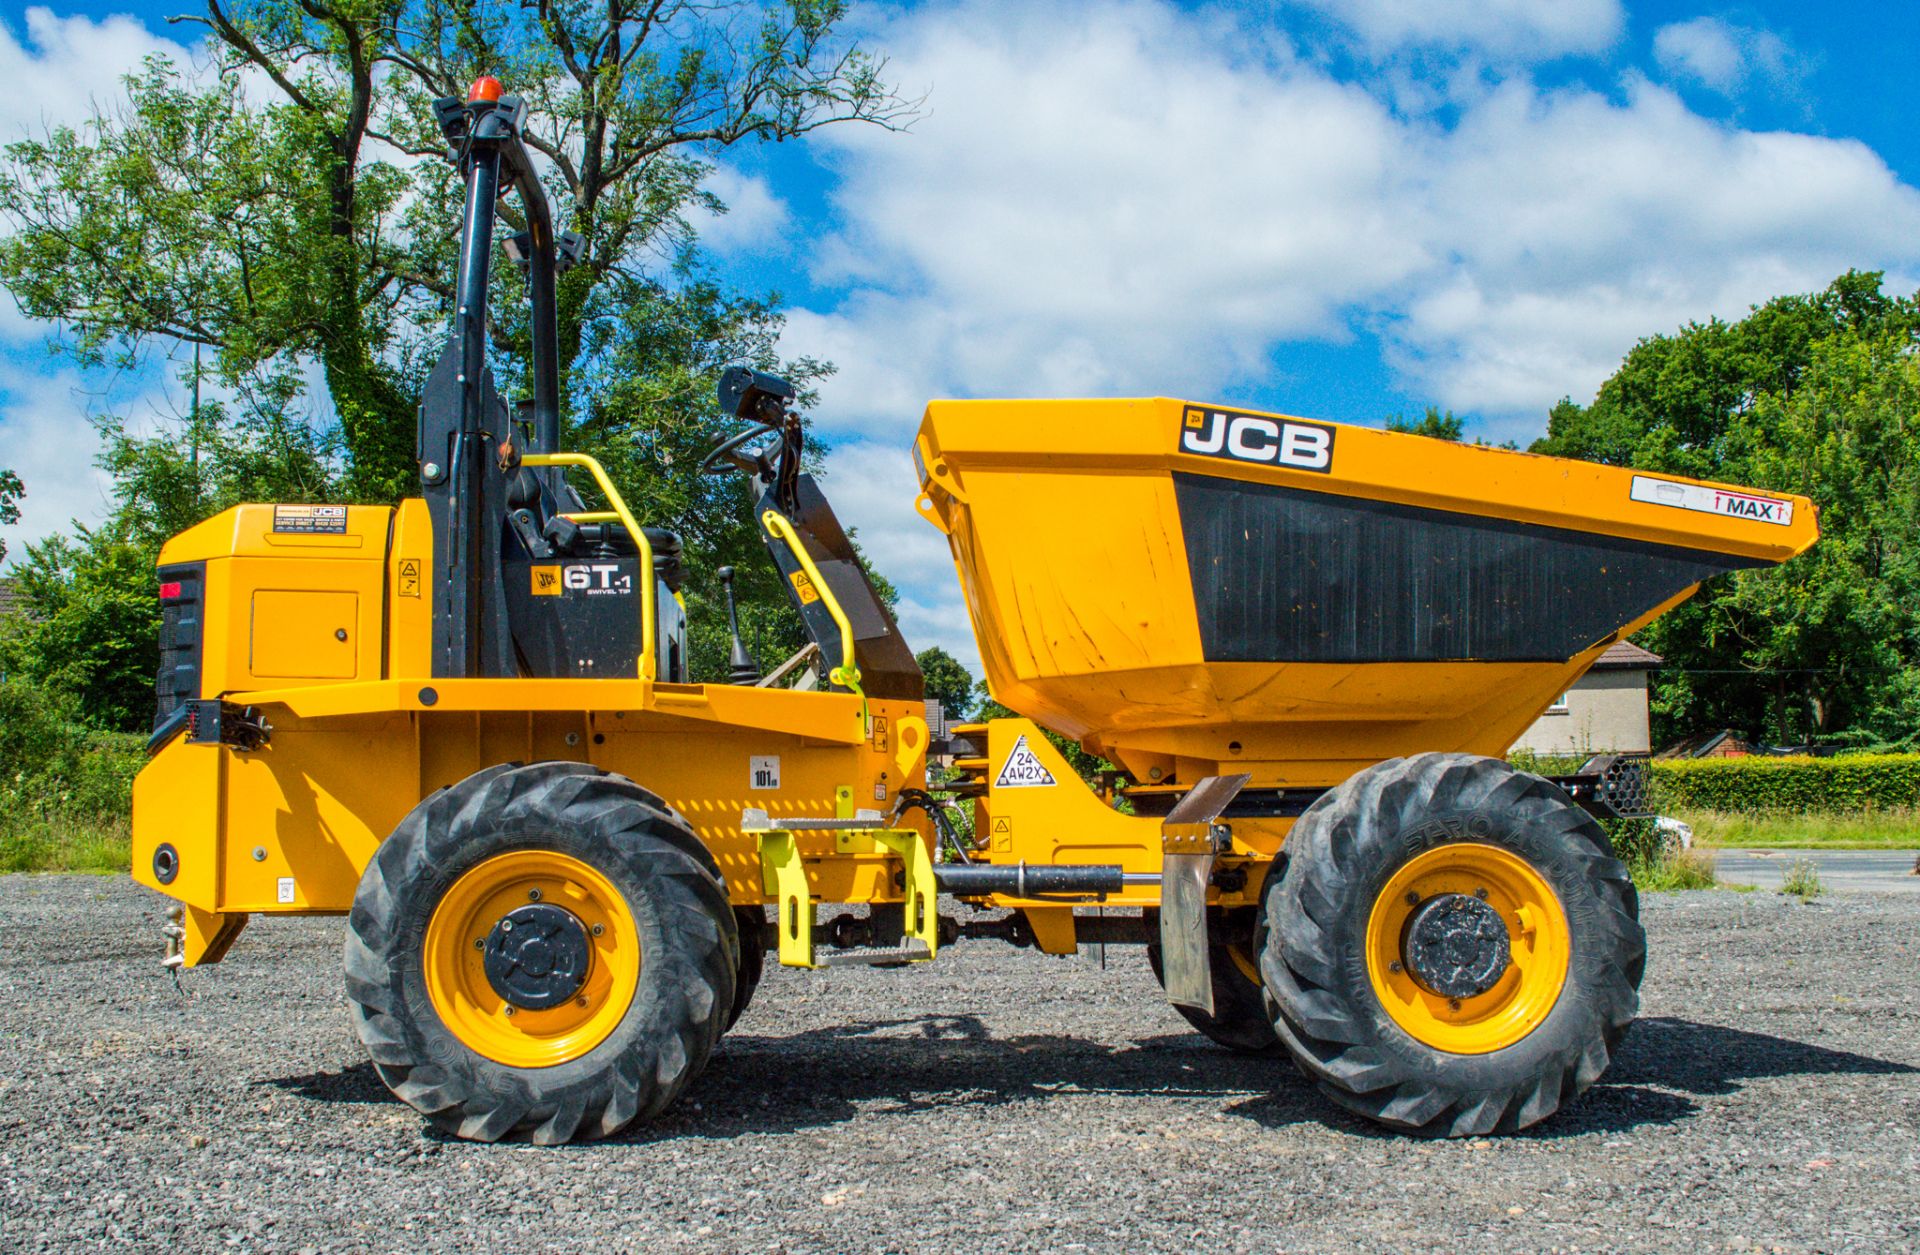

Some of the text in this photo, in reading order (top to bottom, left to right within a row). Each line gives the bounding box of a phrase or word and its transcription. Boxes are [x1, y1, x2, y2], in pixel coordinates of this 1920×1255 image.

[1183, 412, 1331, 469] JCB
[314, 508, 343, 516] JCB
[1726, 498, 1774, 520] MAX
[540, 573, 557, 587] JCB
[1017, 752, 1033, 766] 24
[755, 770, 771, 787] 101
[1009, 767, 1042, 780] AW2X
